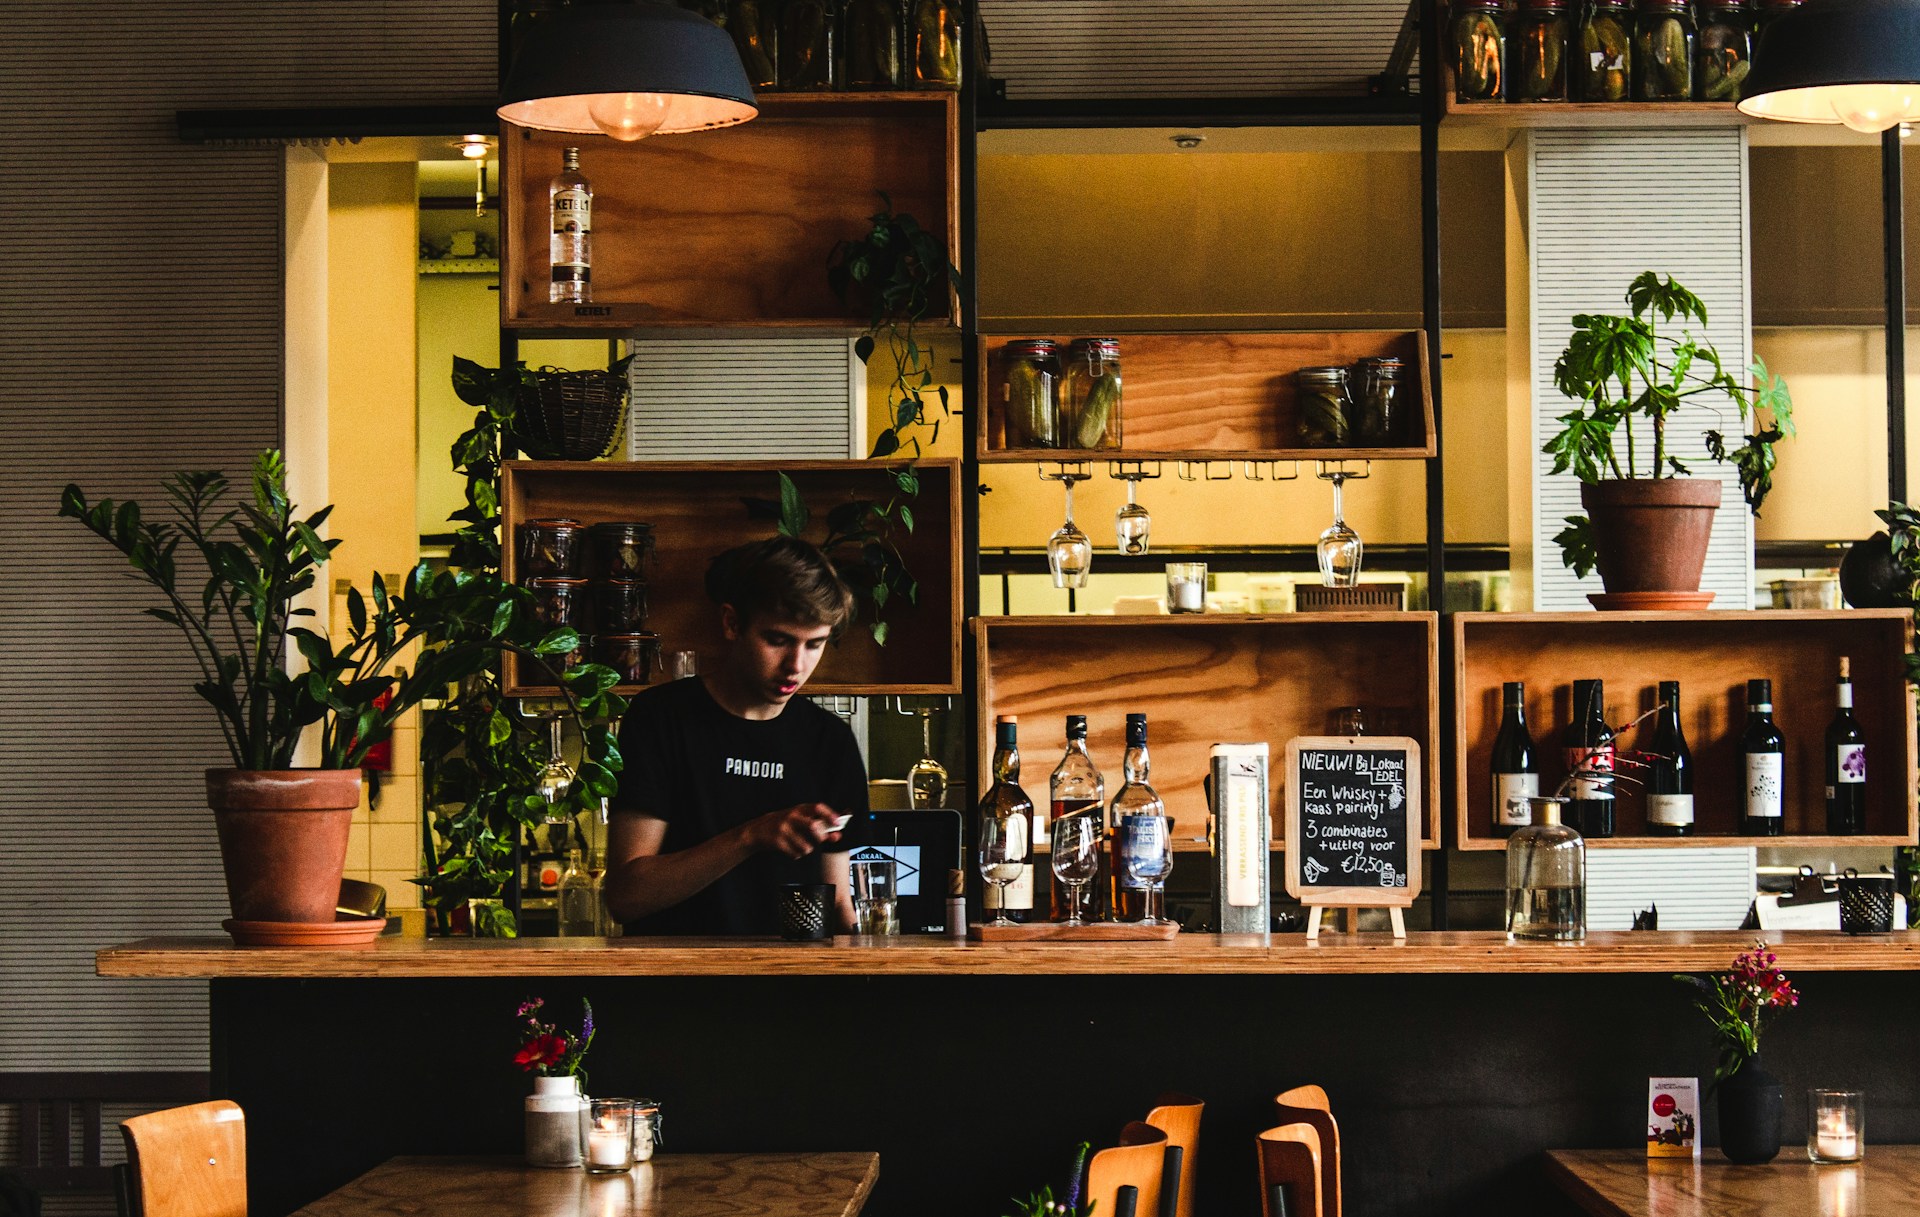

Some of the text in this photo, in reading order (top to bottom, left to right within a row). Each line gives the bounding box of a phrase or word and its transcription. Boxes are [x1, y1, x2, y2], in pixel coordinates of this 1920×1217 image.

[725, 757, 784, 779] PANDOIR
[1355, 754, 1368, 772] Bij
[1370, 754, 1404, 771] Lokaal
[1375, 769, 1403, 782] EDEL
[1303, 782, 1327, 799] Een
[1331, 784, 1376, 806] Whisky
[1305, 819, 1388, 839] 3 combinaties
[1370, 841, 1396, 851] voor
[856, 852, 884, 860] LOKAAL
